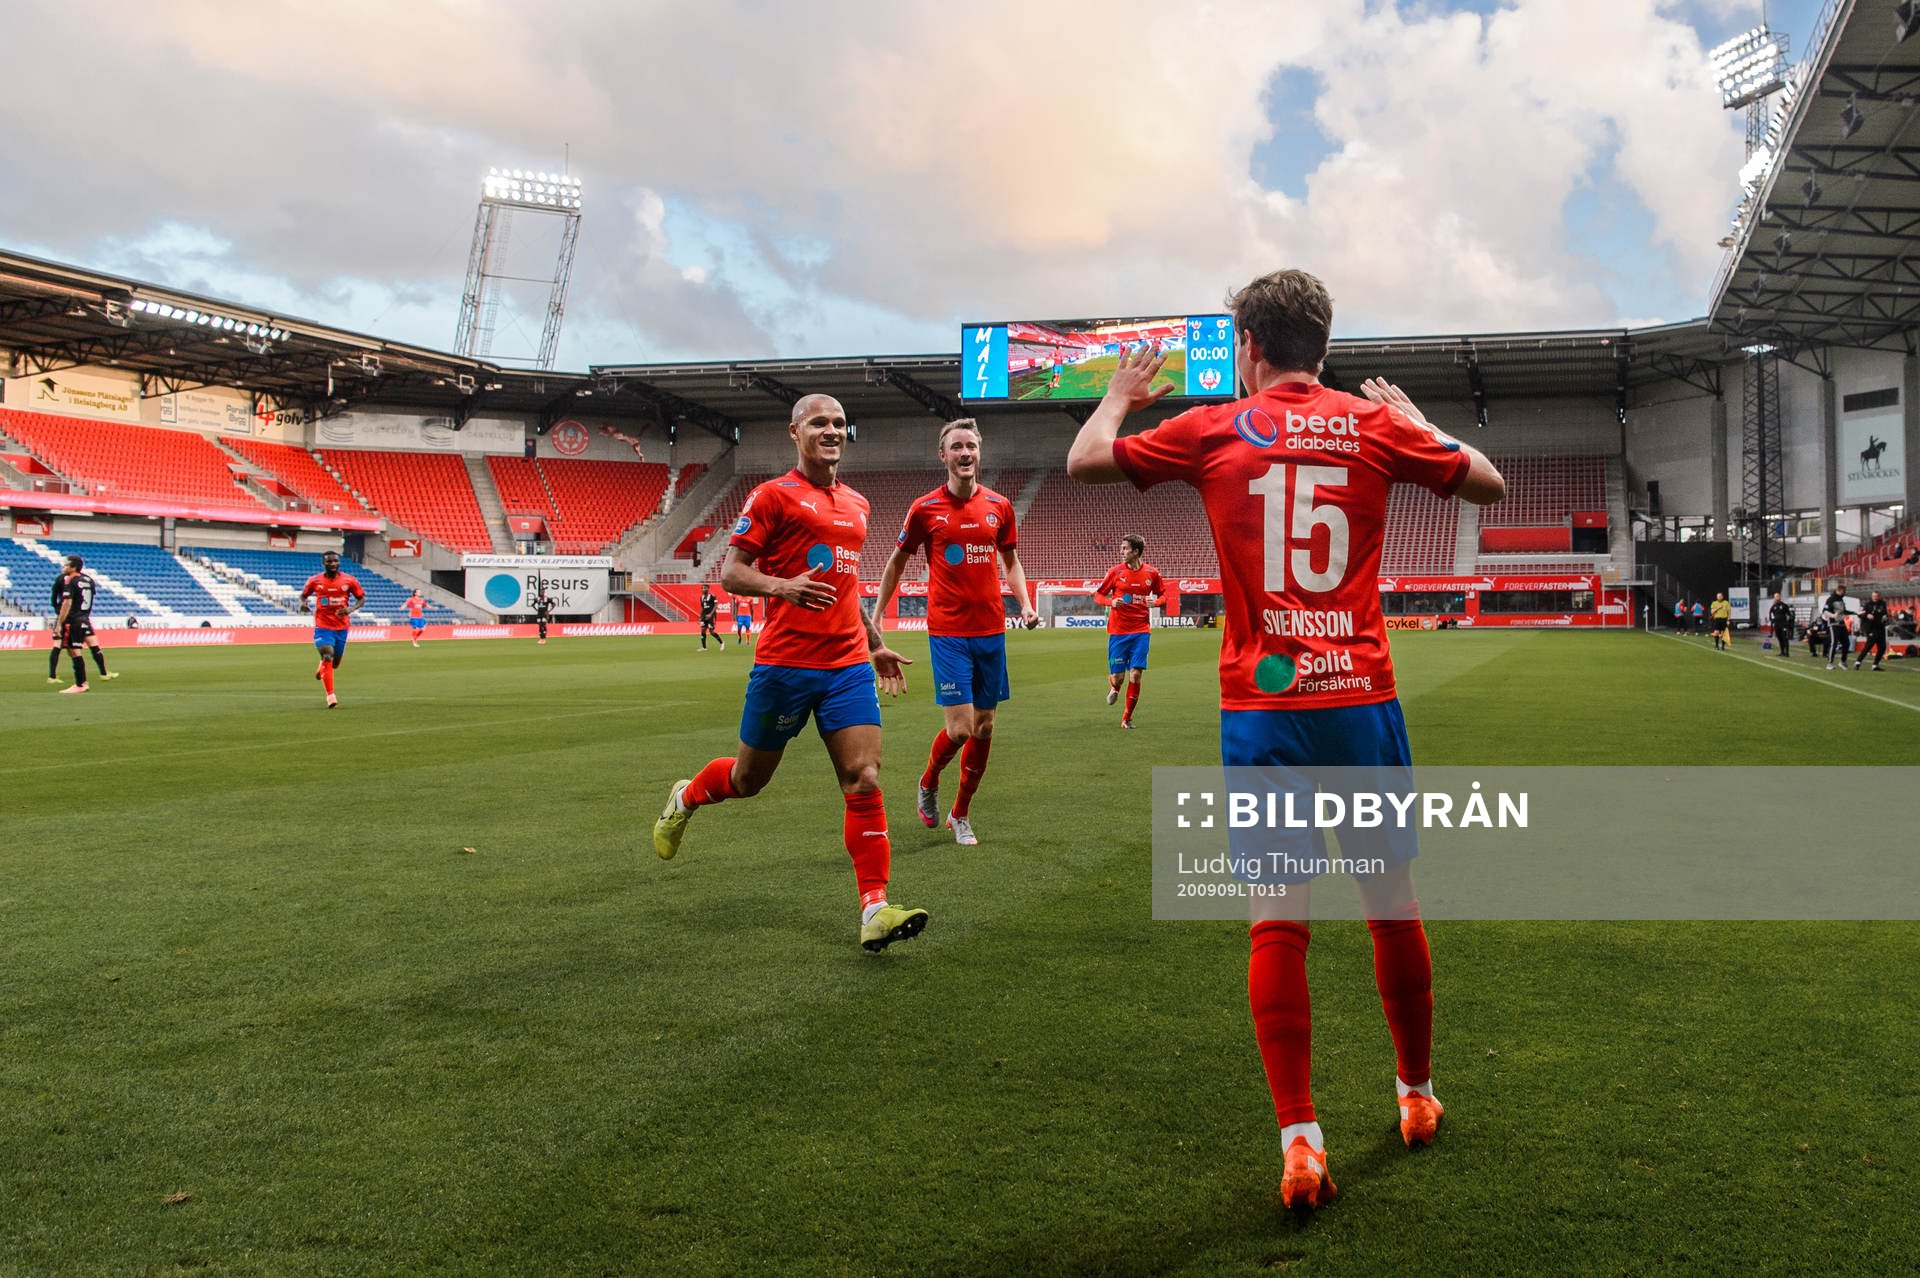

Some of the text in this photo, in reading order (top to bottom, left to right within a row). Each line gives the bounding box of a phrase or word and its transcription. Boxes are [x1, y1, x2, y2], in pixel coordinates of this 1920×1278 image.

[1193, 330, 1200, 341] 0
[1218, 329, 1226, 340] 0
[1190, 346, 1229, 361] 00:00
[1286, 410, 1360, 437] beat
[1285, 437, 1361, 453] diabetes
[1248, 463, 1350, 593] 15
[967, 554, 990, 564] Bank
[526, 575, 589, 590] Resurs
[1179, 580, 1209, 593] Carlsberg
[526, 592, 571, 608] Bnk
[1262, 609, 1354, 637] SVENSSON
[1386, 618, 1419, 630] cykel
[1298, 650, 1353, 675] Solid
[1298, 675, 1372, 692] Försäkring
